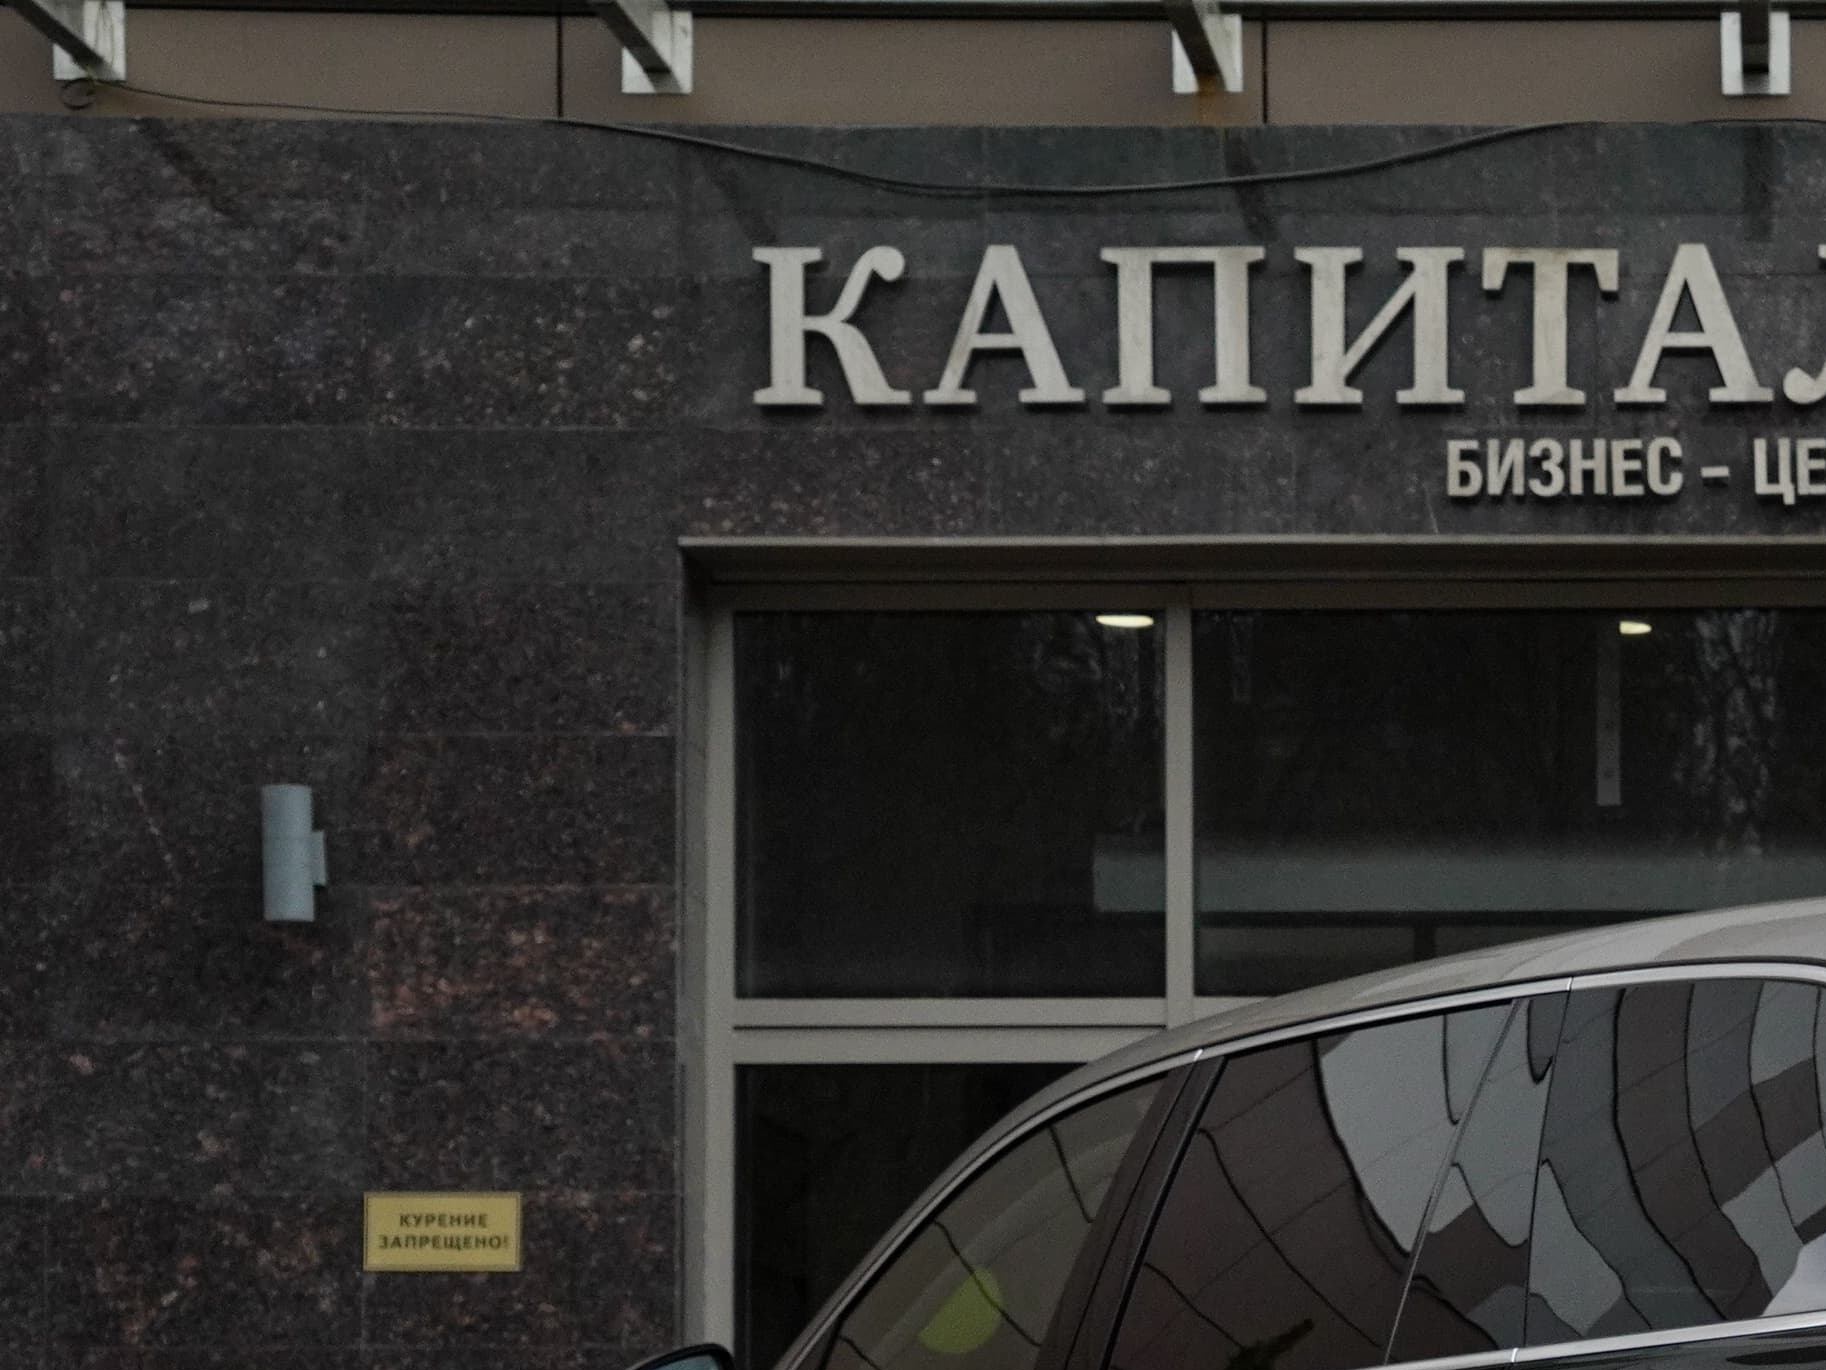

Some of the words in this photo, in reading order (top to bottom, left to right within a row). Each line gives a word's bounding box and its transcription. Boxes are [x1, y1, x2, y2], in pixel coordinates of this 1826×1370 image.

[1446, 436, 1684, 498] БИЗНЕС
[400, 1213, 489, 1229] КУРЕНИЕ
[378, 1234, 509, 1251] ЗАПРЕЩЕНО!
